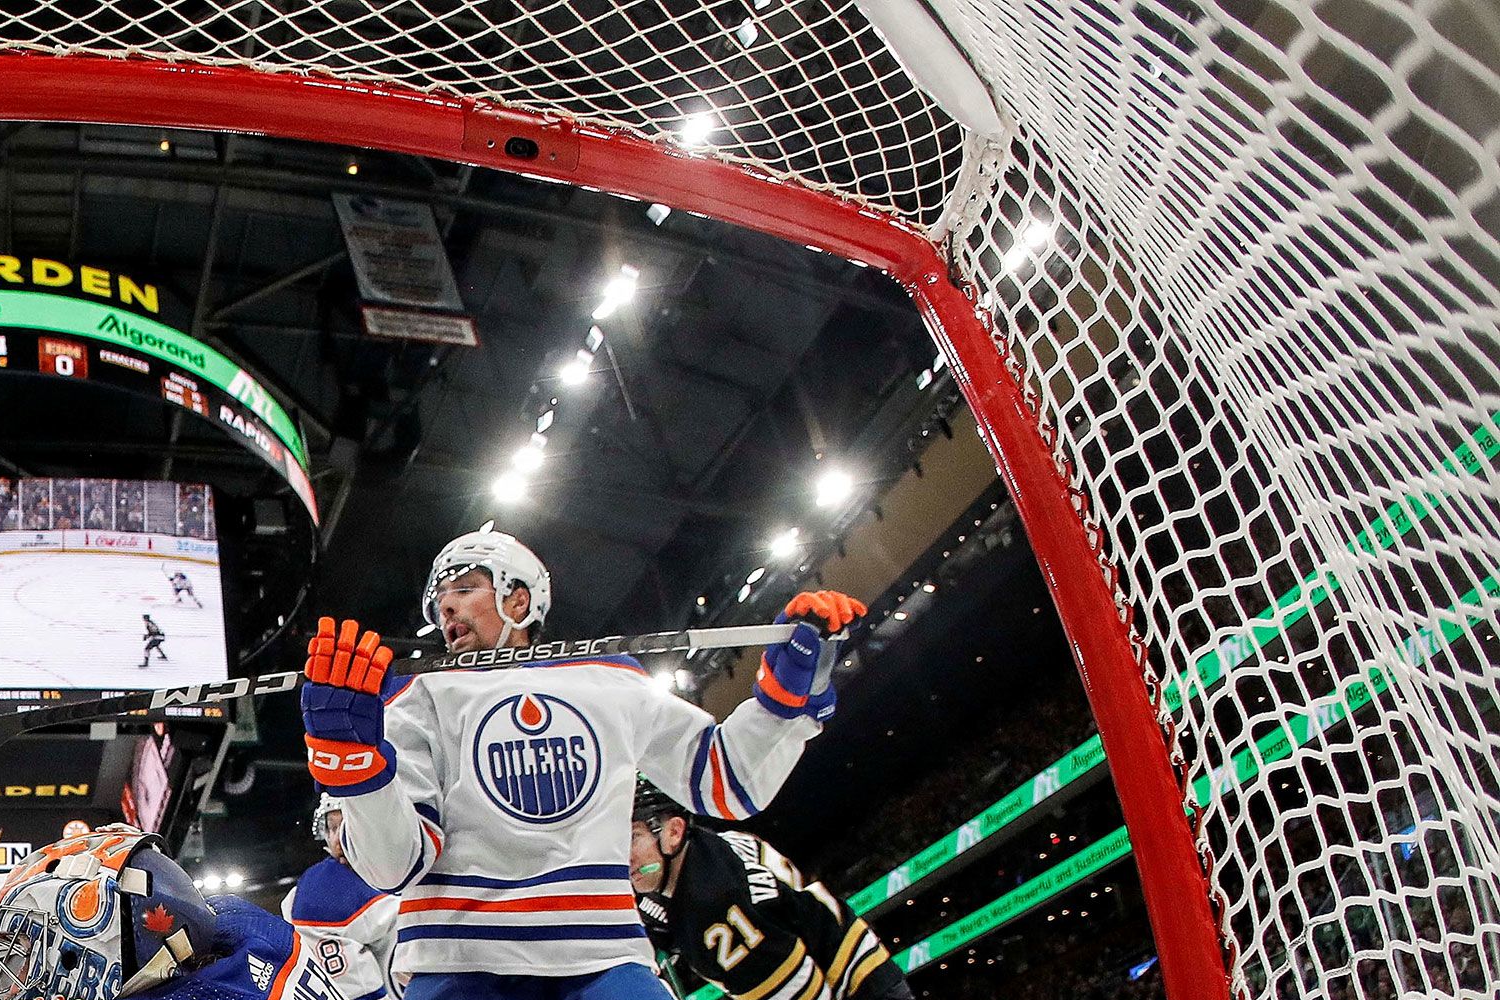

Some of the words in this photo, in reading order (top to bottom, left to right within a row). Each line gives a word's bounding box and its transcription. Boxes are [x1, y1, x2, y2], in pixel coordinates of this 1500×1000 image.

[97, 312, 206, 370] Algorand
[55, 355, 75, 376] 0
[458, 638, 613, 668] JETSPEED
[149, 671, 300, 709] CCM
[487, 735, 588, 806] OILERS
[703, 904, 765, 972] 21
[257, 961, 275, 992] adidas
